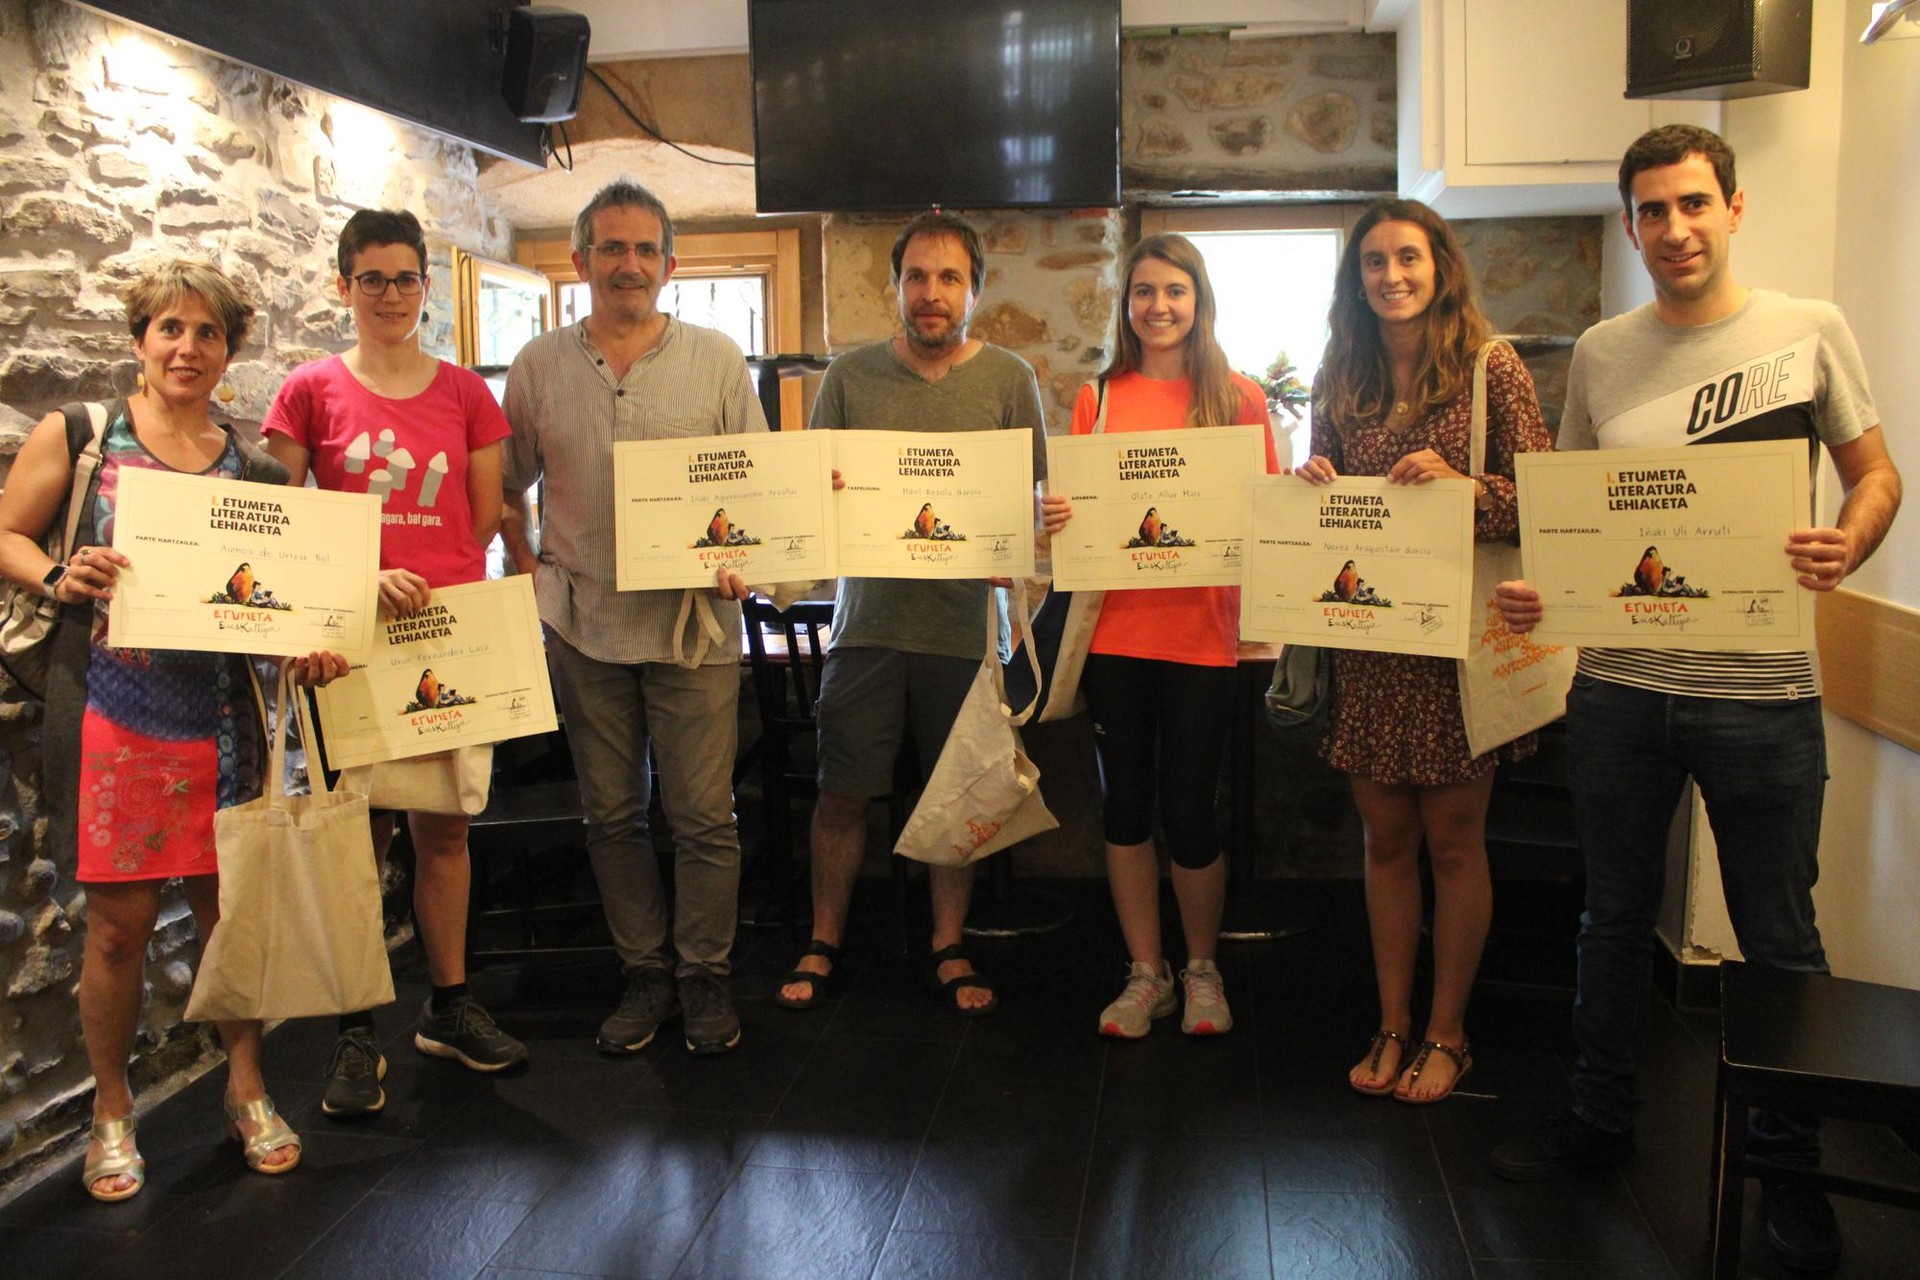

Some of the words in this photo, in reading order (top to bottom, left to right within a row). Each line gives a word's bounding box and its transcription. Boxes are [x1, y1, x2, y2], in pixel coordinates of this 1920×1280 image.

[1686, 352, 1795, 435] CORE
[697, 450, 747, 462] ETUMETA
[907, 448, 954, 457] ETUMETA
[1127, 446, 1179, 459] ETUMETA
[688, 459, 754, 473] LITERATURA
[899, 457, 961, 467] LITERATURA
[1118, 457, 1187, 470] LITERATURA
[689, 470, 748, 483] LEHIAKETA
[899, 467, 955, 477] LEHIAKETA
[1119, 469, 1180, 481] LEHIAKETA
[1618, 469, 1687, 483] ETUMETA
[1607, 483, 1697, 498] LITERATURA
[222, 497, 283, 514] ETUMETA
[1329, 494, 1384, 506] ETUMETA
[1608, 498, 1689, 511] LEHIAKETA
[210, 508, 290, 526] LITERATURA
[1320, 506, 1391, 519] LITERATURA
[407, 512, 421, 525] bat
[421, 515, 443, 527] gara.
[1319, 518, 1383, 530] LEHIAKETA
[210, 519, 282, 536] LEHIAKETA
[699, 549, 747, 560] ETUMETA
[906, 544, 952, 553] ETUMETA
[1131, 550, 1180, 561] ETUMETA
[1323, 607, 1374, 619] ETUMETA
[1624, 601, 1688, 613] ETUMETA
[214, 609, 273, 622] ETUMETA
[387, 615, 457, 634] LITERATURA
[388, 627, 452, 645] LEHIAKETA
[411, 709, 462, 726] ETUMETA
